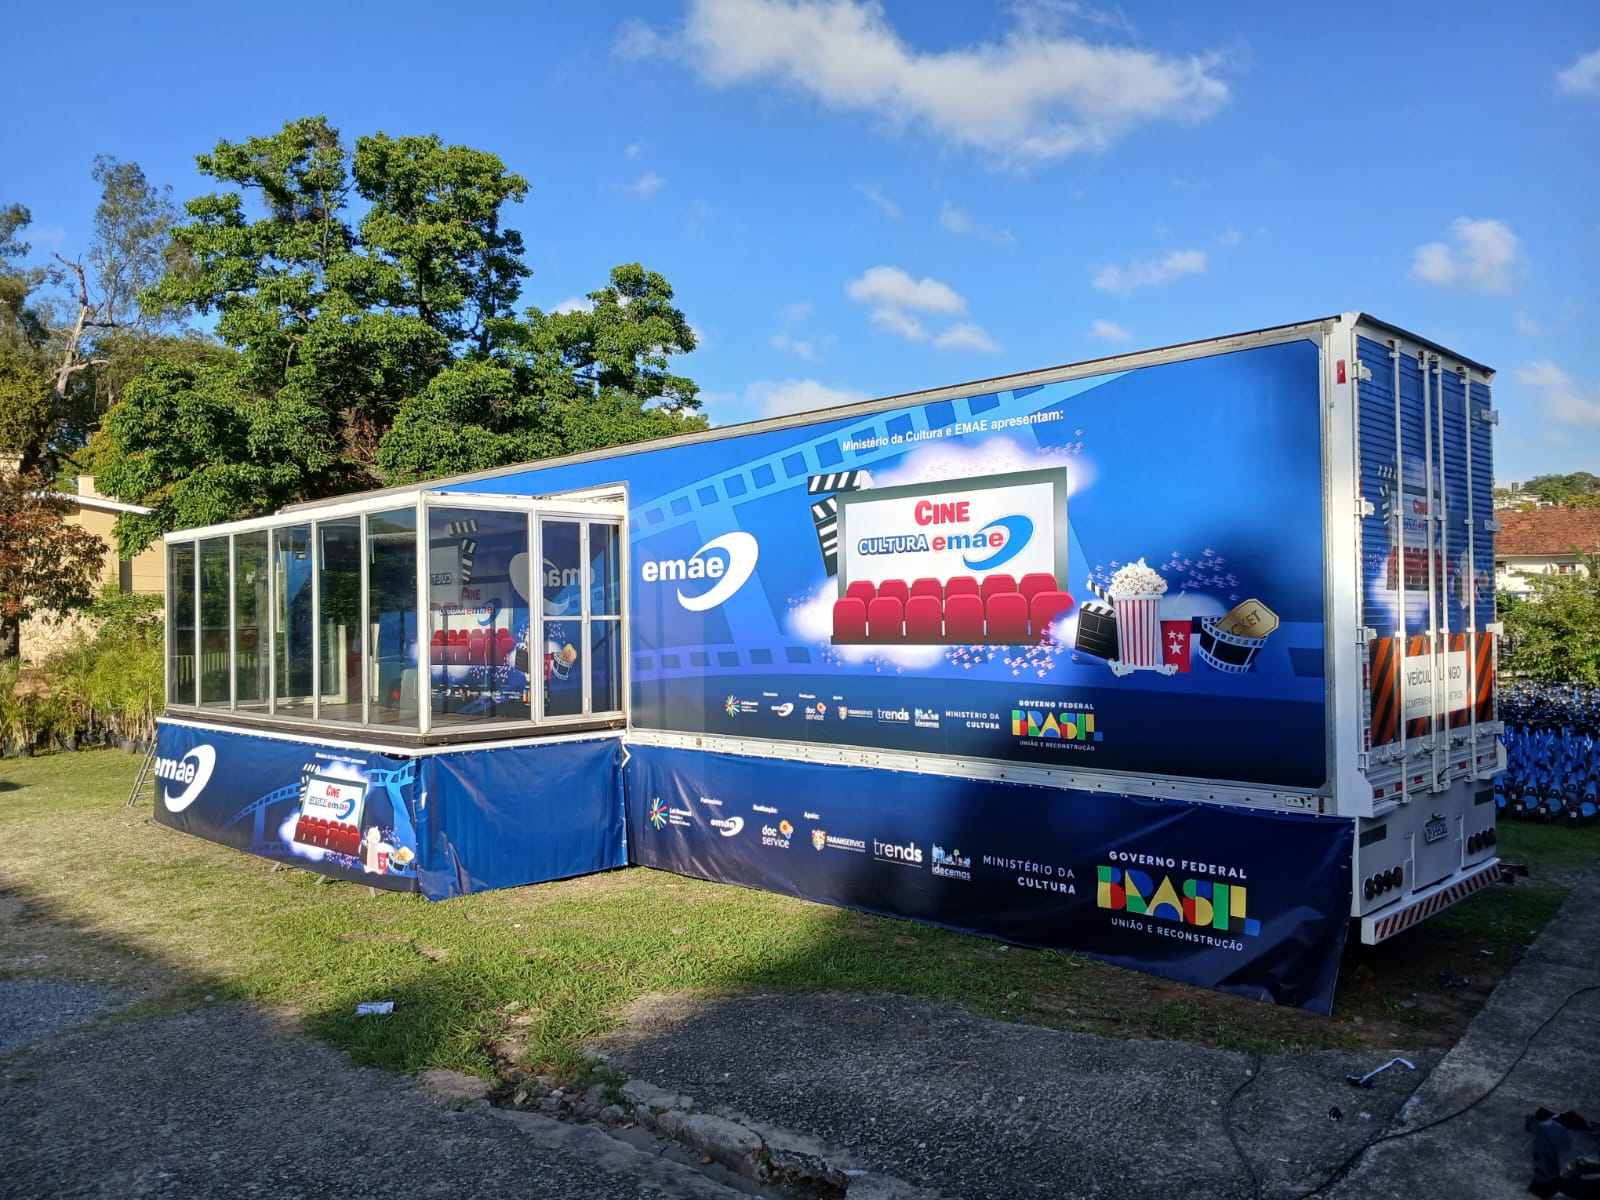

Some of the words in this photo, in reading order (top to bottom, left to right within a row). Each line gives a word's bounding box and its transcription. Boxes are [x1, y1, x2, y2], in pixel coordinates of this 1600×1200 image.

[842, 435, 889, 452] Ministério
[891, 433, 904, 445] da
[905, 430, 943, 442] Cultura
[945, 428, 952, 436] e
[955, 419, 988, 436] EMAE
[990, 410, 1064, 431] apresentam:
[914, 500, 970, 526] CINE
[858, 533, 930, 556] CULTURA
[932, 532, 1004, 551] emae
[641, 556, 725, 582] emae
[1406, 668, 1432, 687] VEÍCUL
[877, 707, 910, 721] trends
[945, 710, 988, 720] MINISTÉRIO
[1019, 700, 1056, 708] GOVERNO
[1058, 702, 1095, 710] FEDERAL
[966, 721, 1000, 730] CULTURA
[1012, 709, 1103, 742] BRASIL
[1045, 742, 1096, 752] RECONSTRUÇÃO
[154, 756, 195, 784] emae
[762, 824, 777, 836] doc
[762, 836, 790, 849] service
[873, 837, 923, 863] trends
[931, 864, 971, 880] idecemas
[983, 854, 1053, 876] MINISTÉRIO
[1058, 867, 1076, 879] DA
[1108, 851, 1176, 868] GOVERNO
[1181, 860, 1247, 879] FEDERAL
[1017, 876, 1076, 895] CULTURA
[1097, 865, 1261, 937] BRASIL
[1111, 917, 1144, 931] UNIÃO
[1147, 924, 1153, 933] E
[1157, 926, 1243, 952] RECONSTRUÇÃO
